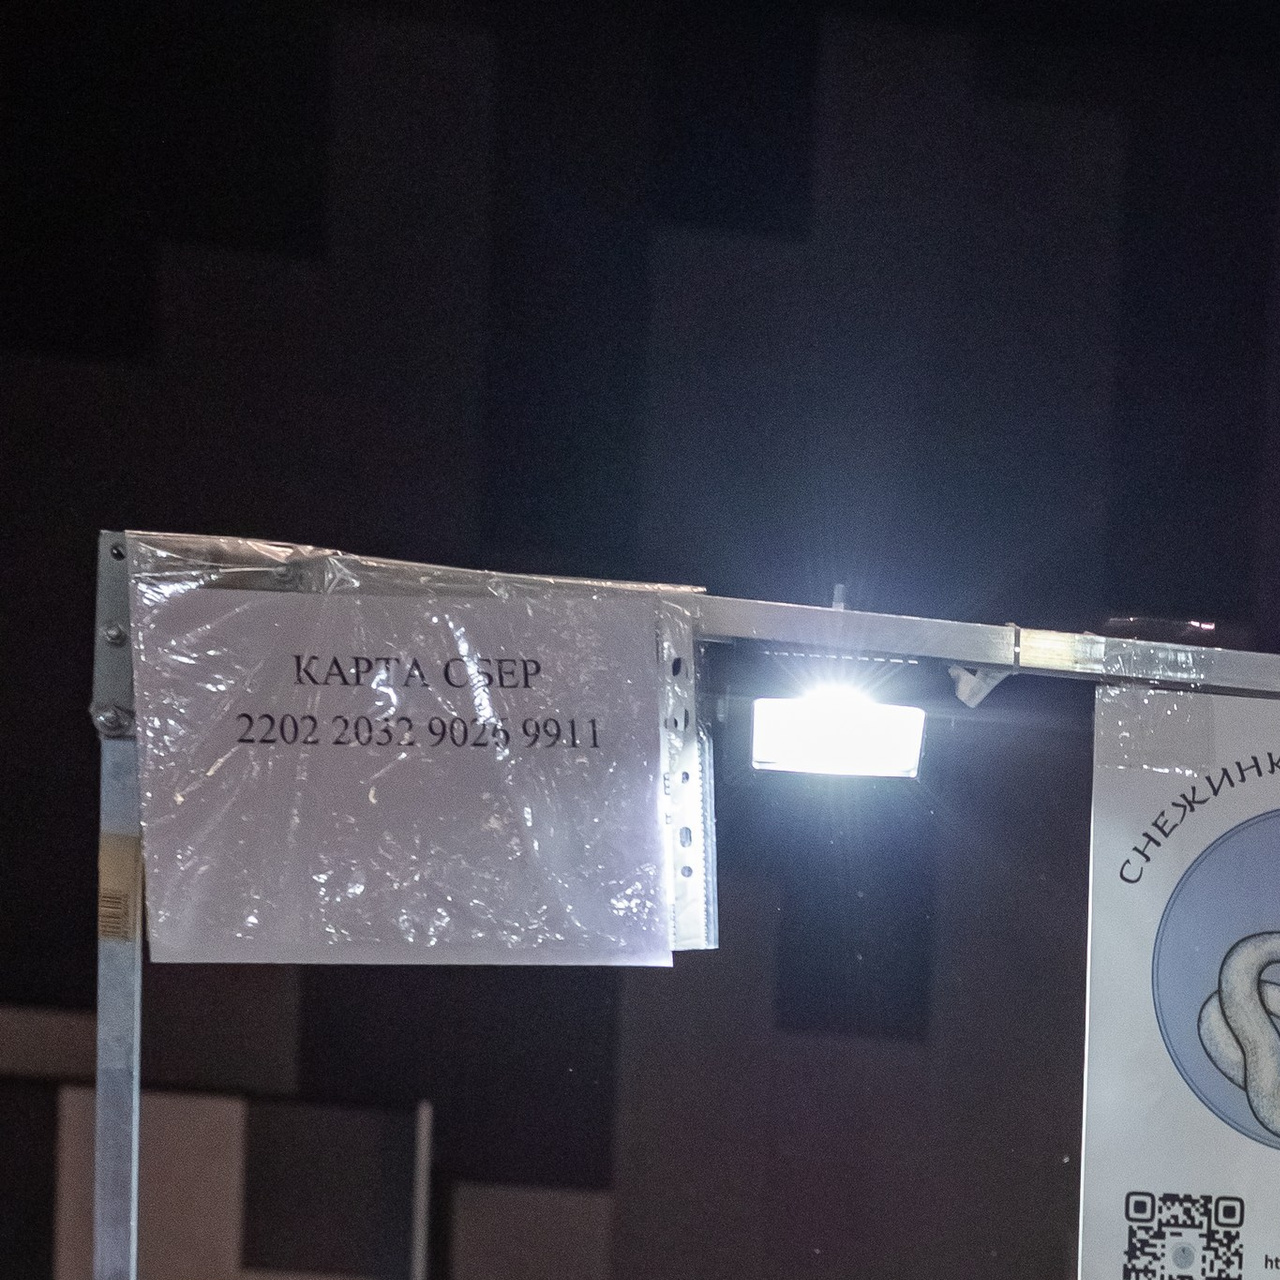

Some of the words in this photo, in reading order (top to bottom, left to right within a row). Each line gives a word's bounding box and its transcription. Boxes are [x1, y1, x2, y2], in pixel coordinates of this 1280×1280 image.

[292, 653, 430, 688] КАРТА
[443, 655, 542, 689] СБЕР
[236, 713, 320, 746] 2202
[331, 715, 415, 747] 2032
[521, 717, 602, 749] 9911
